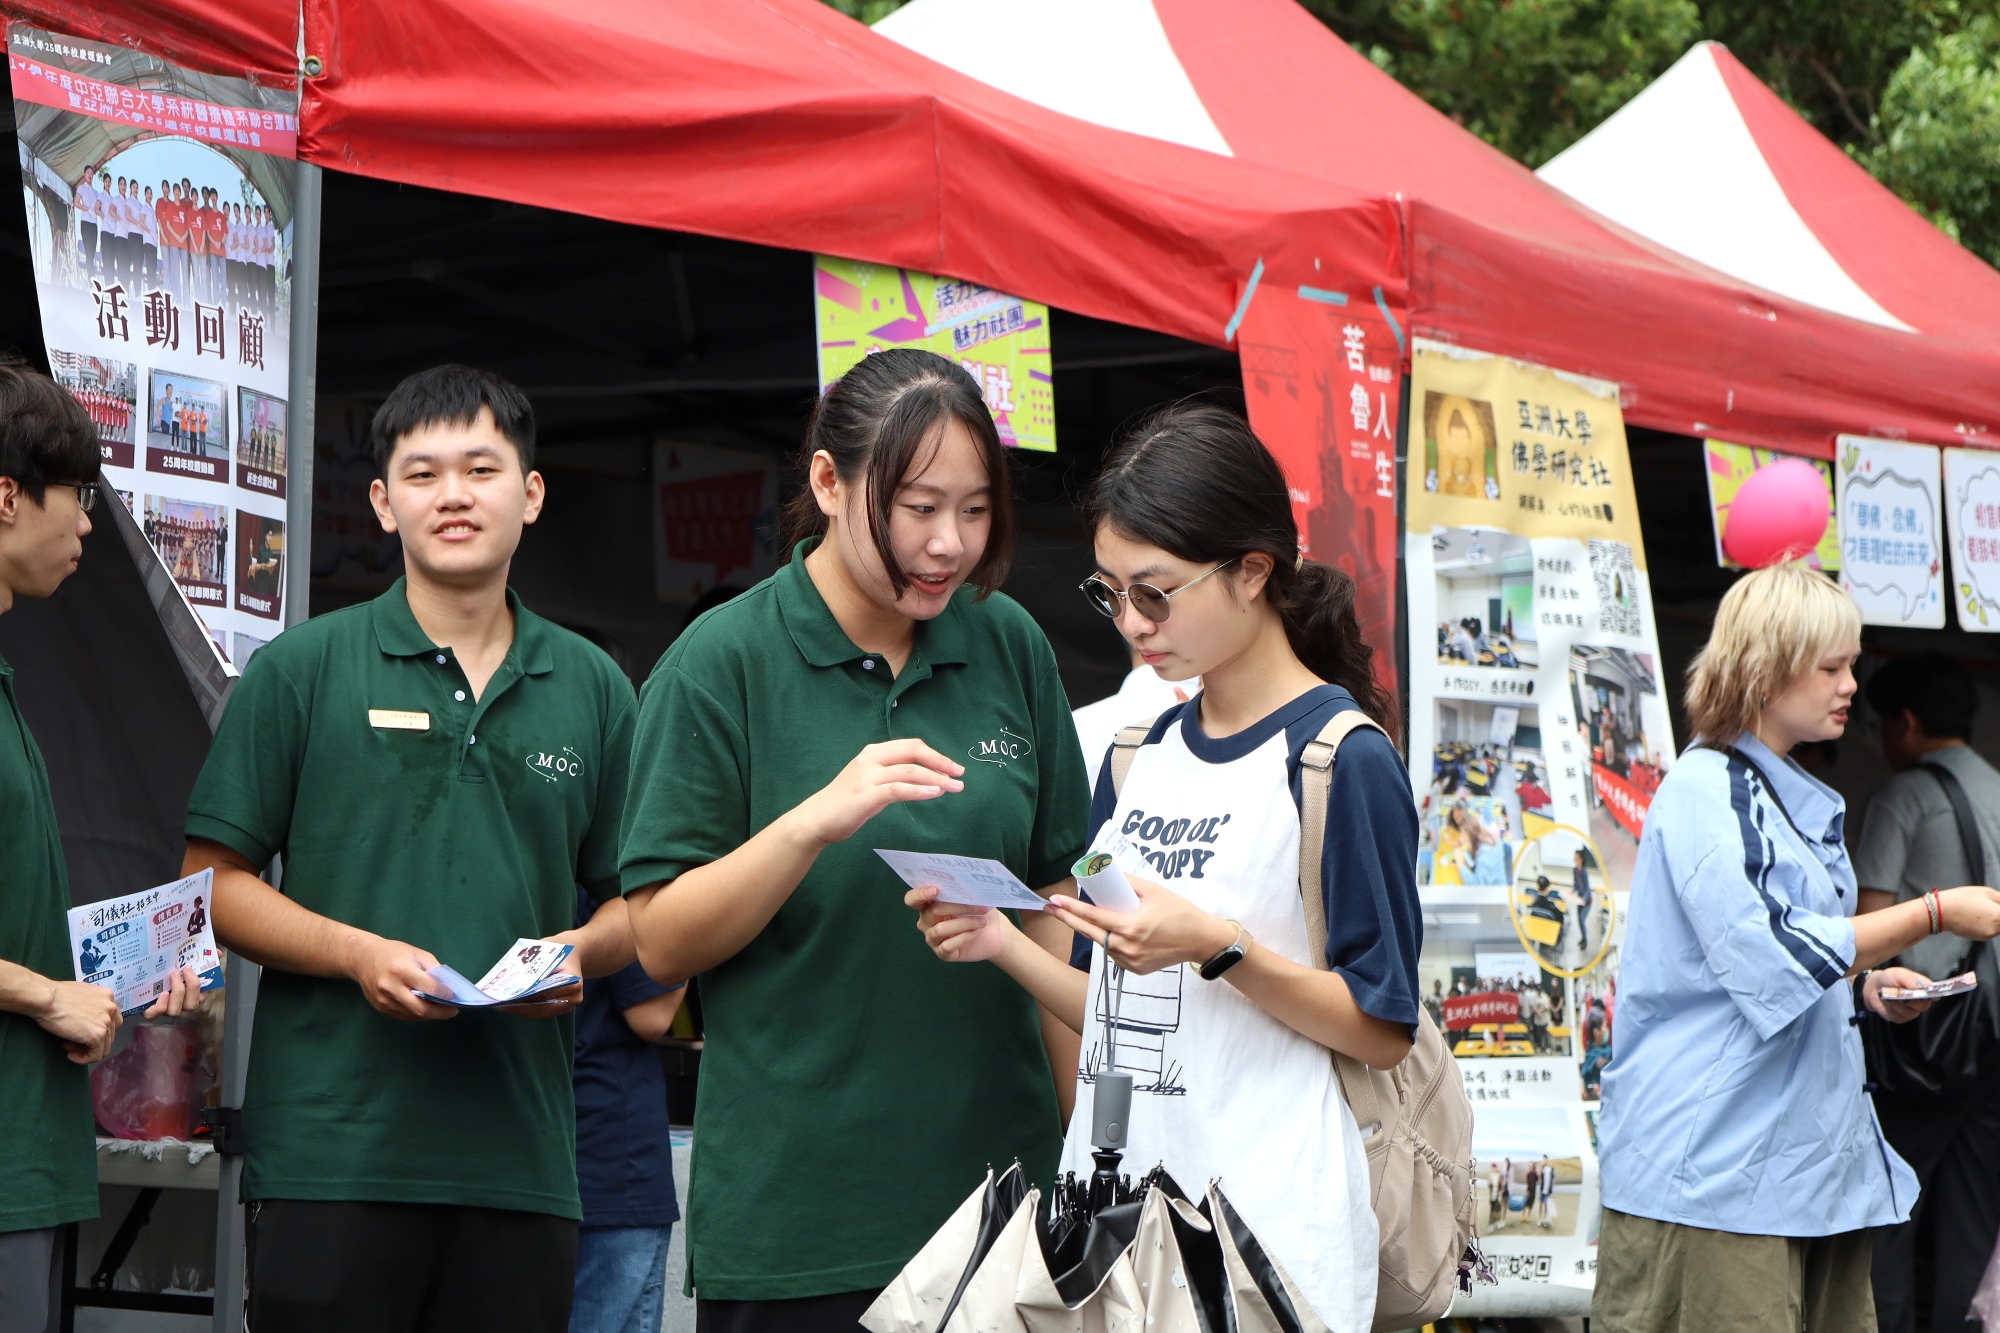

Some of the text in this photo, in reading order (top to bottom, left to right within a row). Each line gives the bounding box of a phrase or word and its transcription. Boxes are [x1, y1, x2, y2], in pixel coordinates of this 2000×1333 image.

[91, 279, 265, 372] 活動回顧
[954, 304, 1025, 349] 魅力社團
[1517, 400, 1592, 445] 亞洲大學
[1511, 440, 1612, 488] 佛學研究社
[535, 752, 579, 777] MOC
[978, 740, 1019, 759] MOC
[1121, 809, 1191, 846] GOOD
[179, 955, 186, 968] 2
